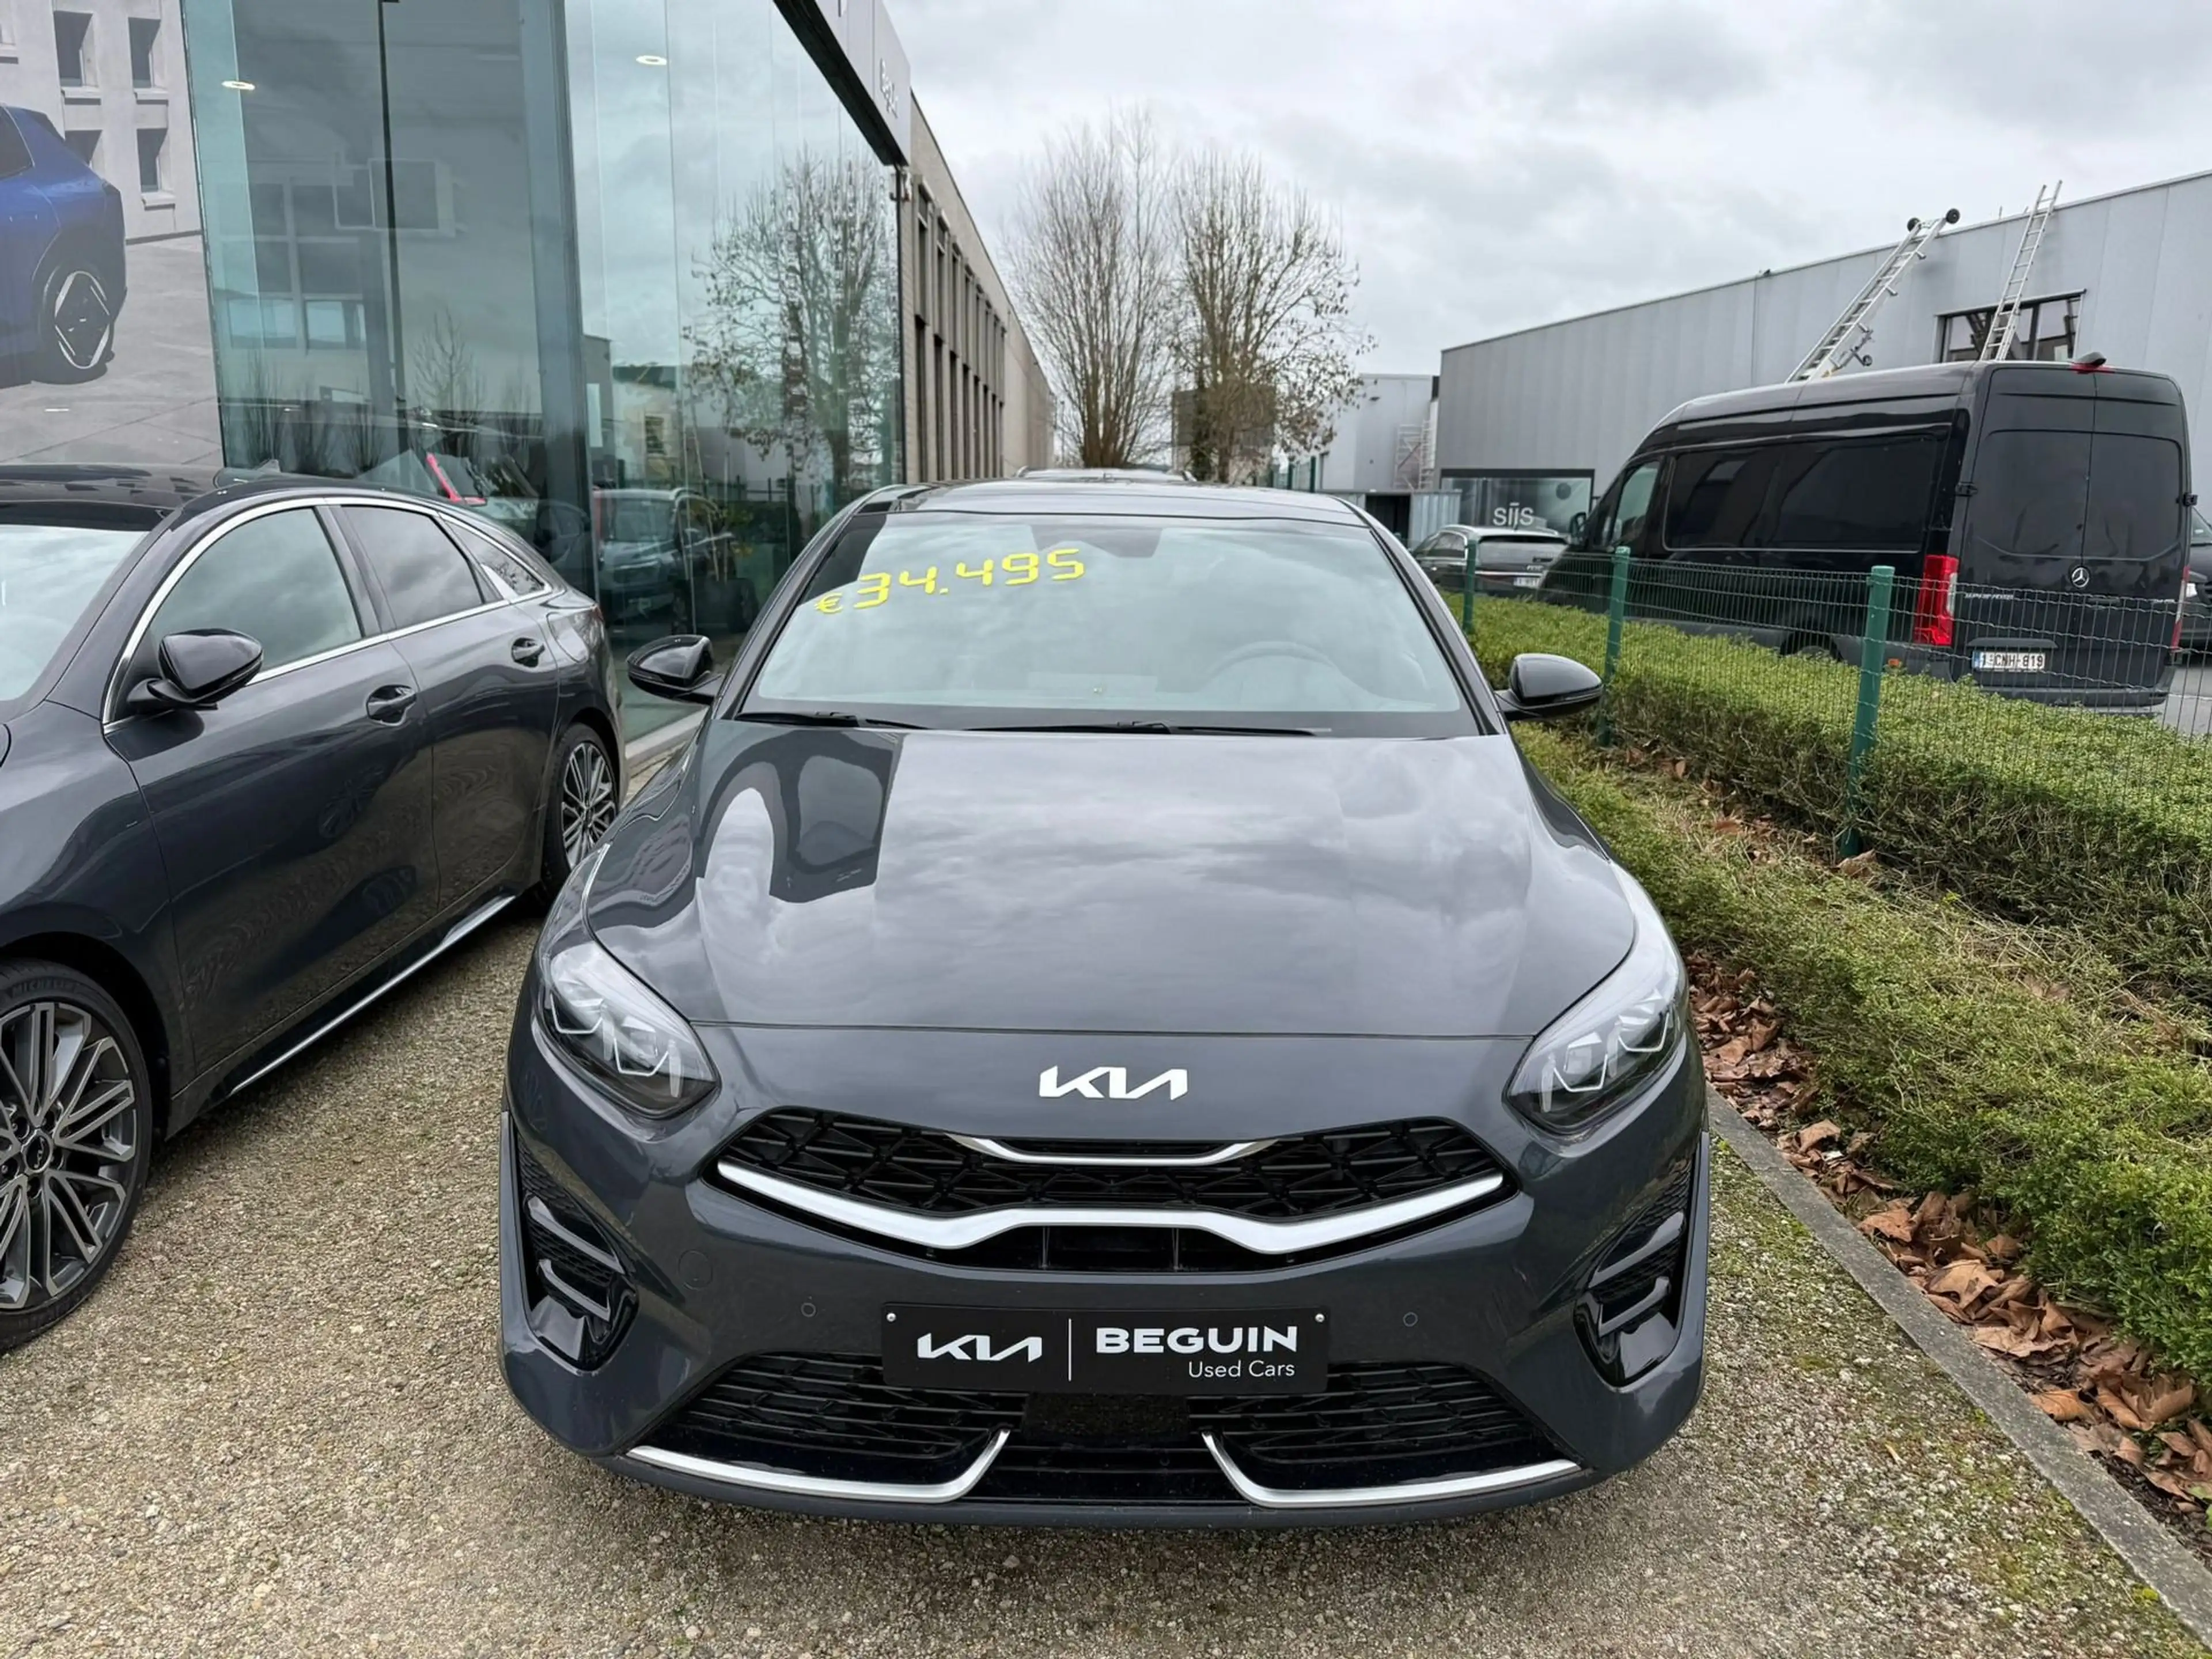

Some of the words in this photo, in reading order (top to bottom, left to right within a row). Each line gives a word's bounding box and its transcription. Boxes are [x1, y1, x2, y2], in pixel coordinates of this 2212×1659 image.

[1039, 1065, 1188, 1100] KIA
[917, 1332, 1042, 1362] KIA
[1096, 1325, 1297, 1354] BEGUIN
[1188, 1359, 1241, 1378] Used
[1248, 1360, 1295, 1378] Cars
